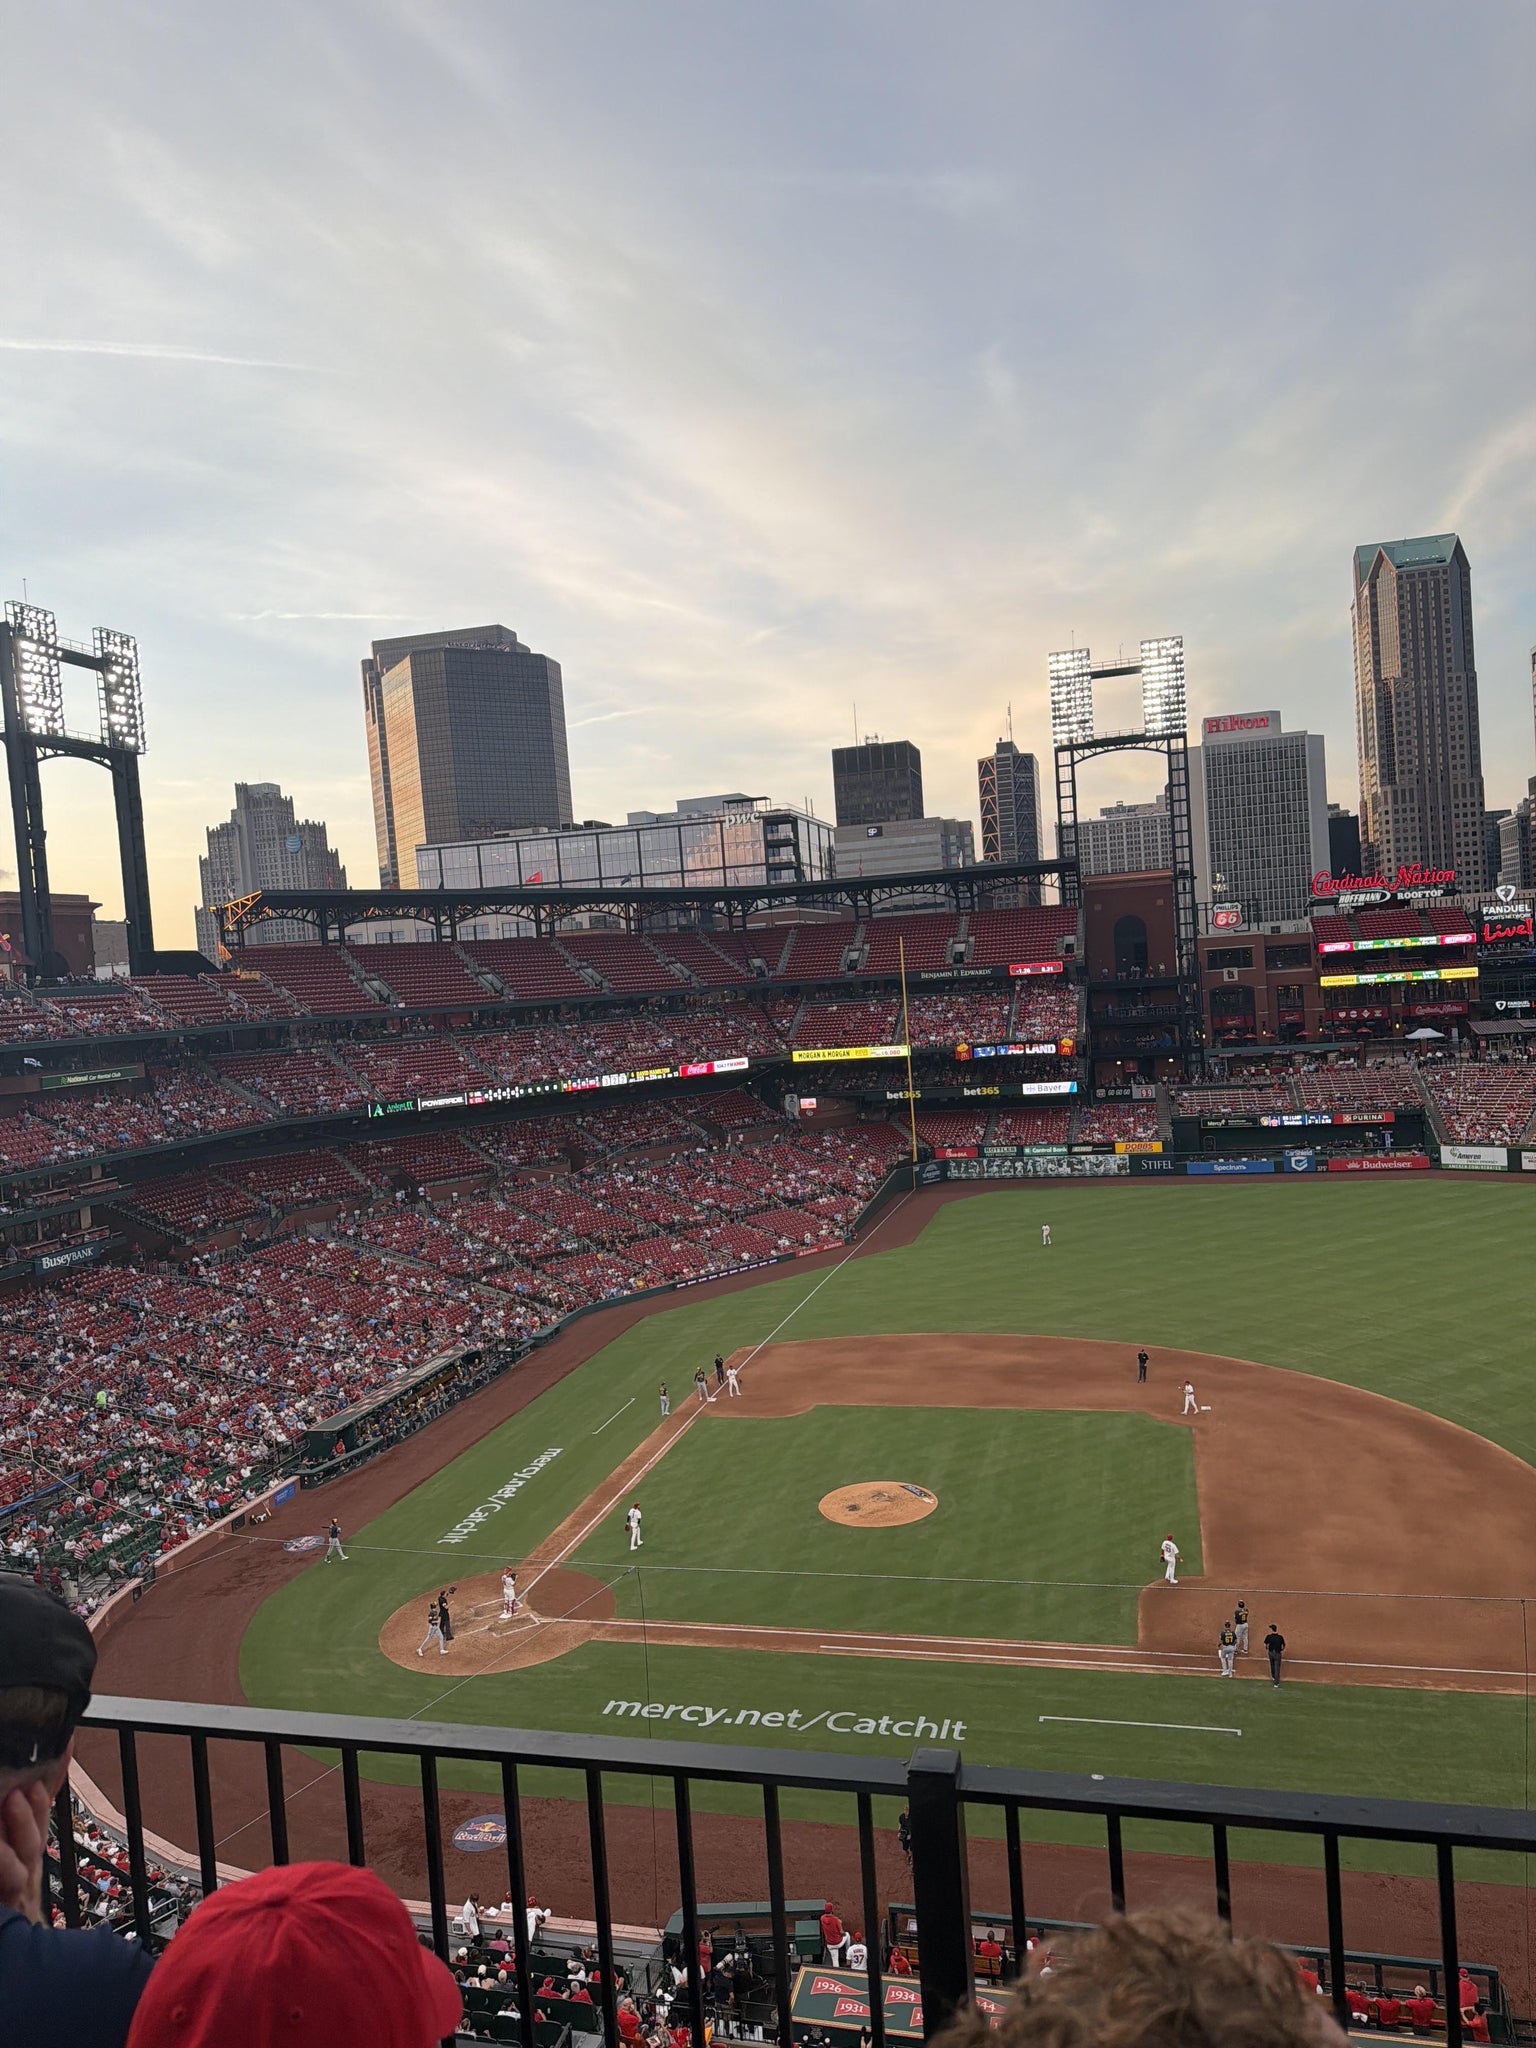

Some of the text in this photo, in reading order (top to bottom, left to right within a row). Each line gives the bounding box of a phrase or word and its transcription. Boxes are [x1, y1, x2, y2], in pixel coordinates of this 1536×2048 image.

[1207, 715, 1269, 733] Hilton
[725, 812, 760, 830] pwc
[1312, 863, 1455, 896] Cardinals Nation
[1339, 889, 1444, 904] HOFFMANN ROOFTOP
[1215, 903, 1239, 911] PHILLIPS
[1483, 904, 1532, 914] FANDUEL
[1216, 912, 1238, 924] 66
[1484, 917, 1533, 942] Live!
[921, 971, 952, 979] BENJAMIN
[1025, 1044, 1056, 1054] LAND
[67, 1075, 88, 1083] National
[886, 1090, 921, 1099] bet365
[963, 1086, 999, 1096] bet365
[421, 1096, 464, 1108] POWERADE
[1457, 1152, 1482, 1160] Ameren
[1141, 1159, 1174, 1169] STIFEL
[1362, 1161, 1412, 1169] Budweiser
[455, 1831, 507, 1843] Red Bull
[853, 1954, 865, 1964] 37
[816, 1981, 842, 1993] 1926
[891, 1990, 916, 2002] 1934
[840, 2003, 864, 2013] 1931
